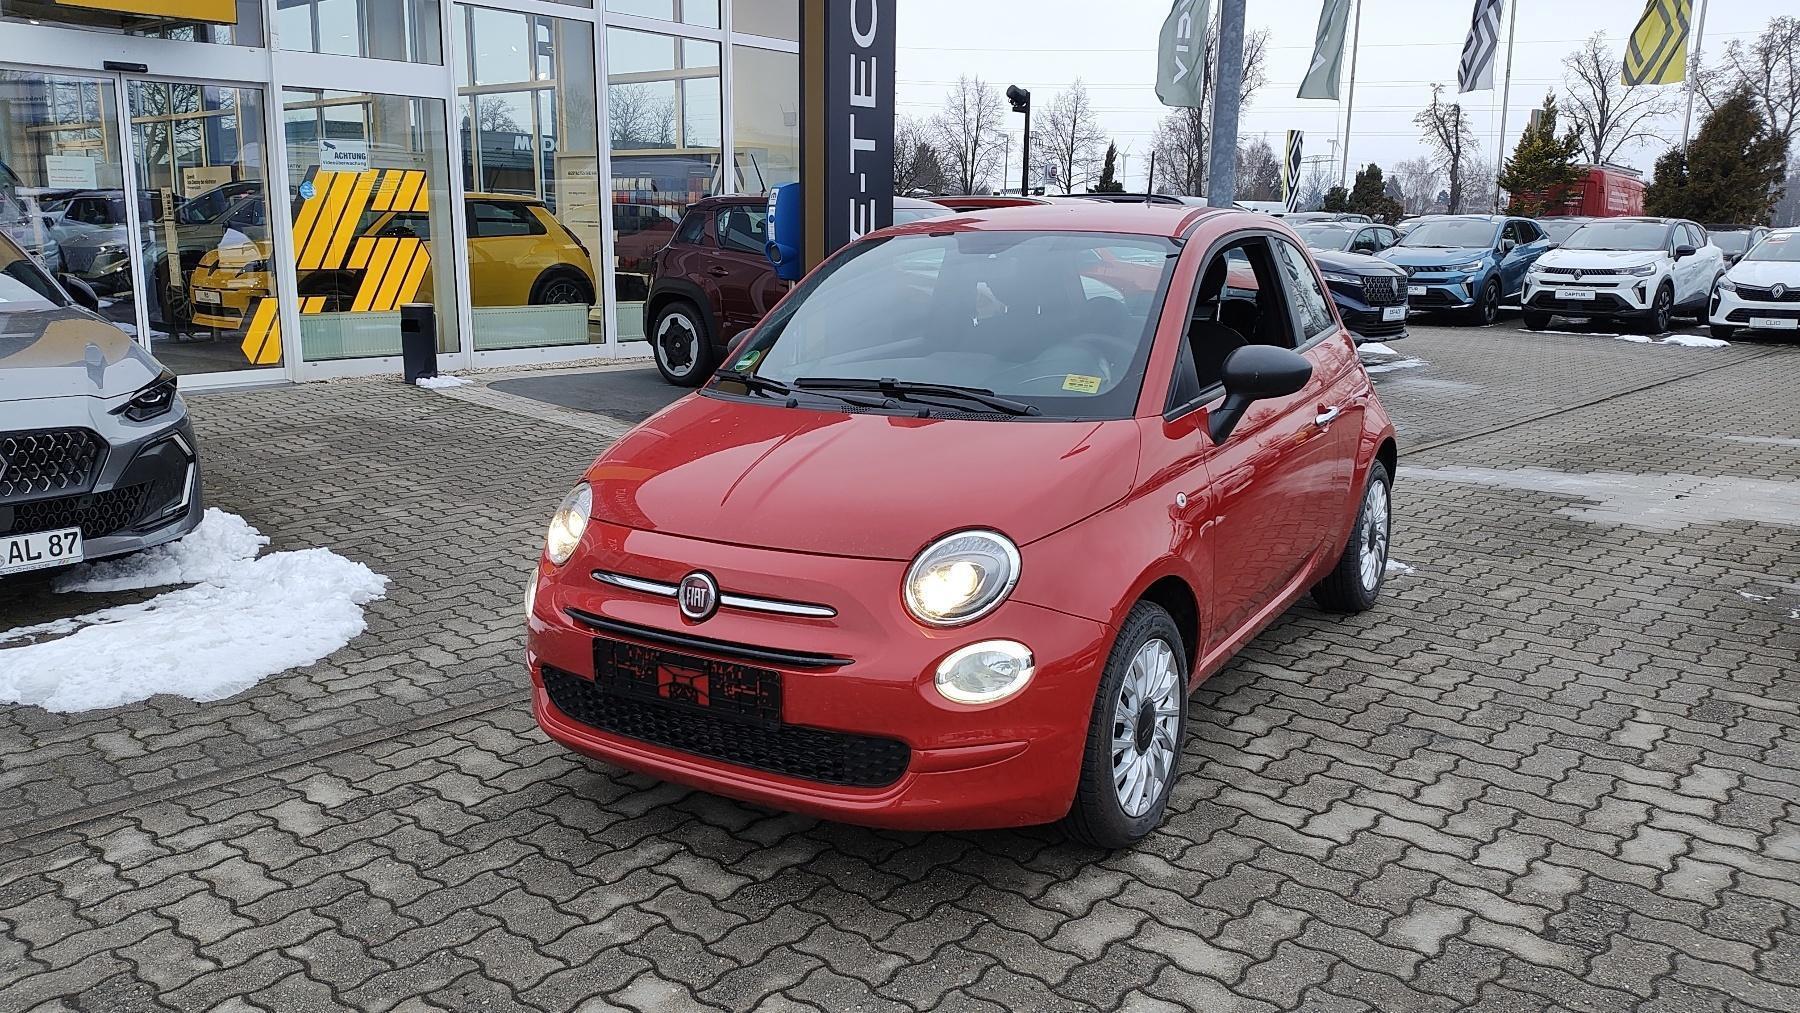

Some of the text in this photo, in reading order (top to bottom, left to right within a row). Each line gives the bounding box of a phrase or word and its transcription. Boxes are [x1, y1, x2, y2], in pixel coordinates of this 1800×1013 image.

[334, 152, 366, 160] ACHTUNG
[9, 532, 78, 564] AL 87
[686, 587, 707, 608] FIAT
